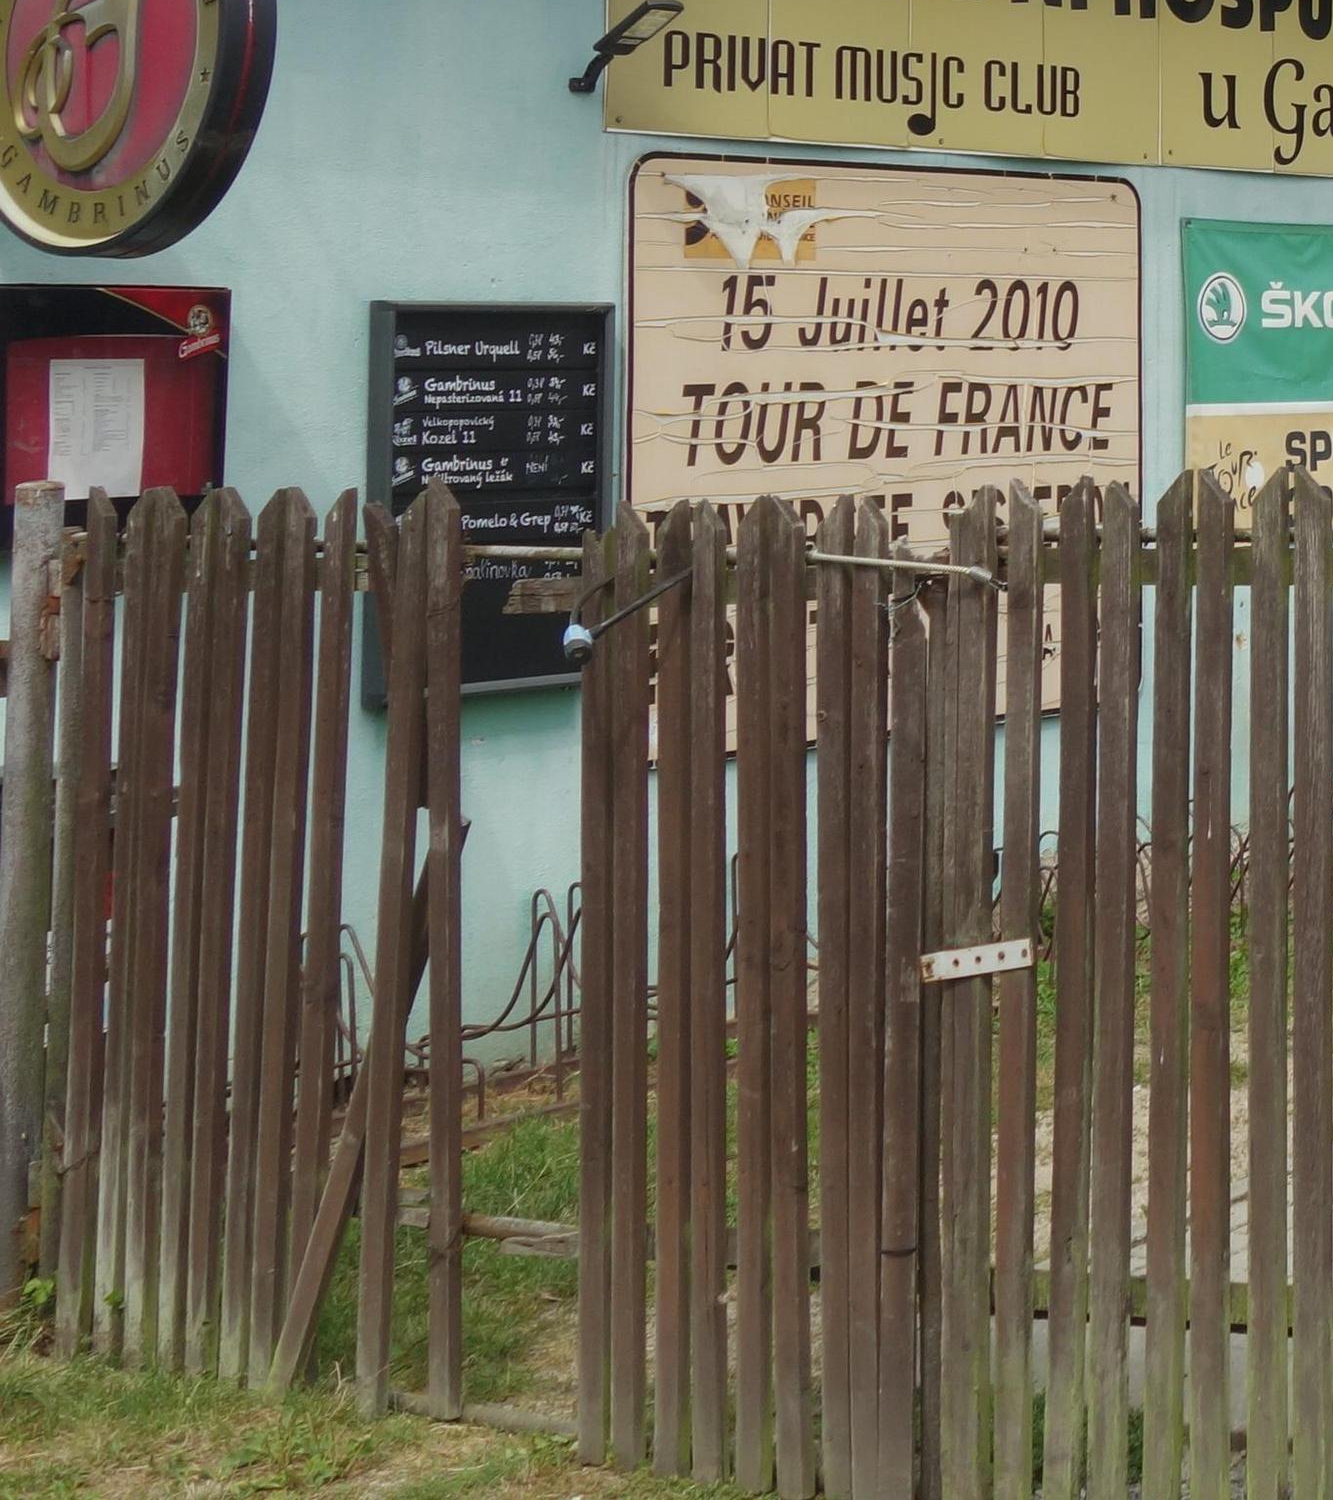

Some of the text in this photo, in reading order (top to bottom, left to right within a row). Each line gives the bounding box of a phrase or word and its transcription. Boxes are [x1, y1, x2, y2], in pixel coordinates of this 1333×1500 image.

[663, 29, 1081, 136] PRIVAT MUSIC CLUB
[1200, 69, 1241, 130] u
[1, 130, 190, 224] GAMBRINUS
[721, 275, 1080, 352] 15 Juillet 2010
[424, 340, 470, 355] Pilsner
[475, 340, 520, 362] Urquell
[583, 341, 596, 355] Kč
[424, 375, 495, 392] Gambrinus
[582, 383, 596, 396] Kč
[424, 391, 504, 409] Nepasterizovaná
[509, 389, 522, 402] 11
[422, 416, 495, 431] Velkopopovický
[581, 422, 594, 436] Kč
[682, 380, 1113, 467] TOUR DE FRANCE
[421, 430, 457, 445] Kozel
[462, 430, 477, 444] 11
[422, 455, 492, 472] Gambrinus
[581, 460, 594, 474] Kč
[461, 513, 507, 530] Pomelo
[519, 512, 551, 533] Grep
